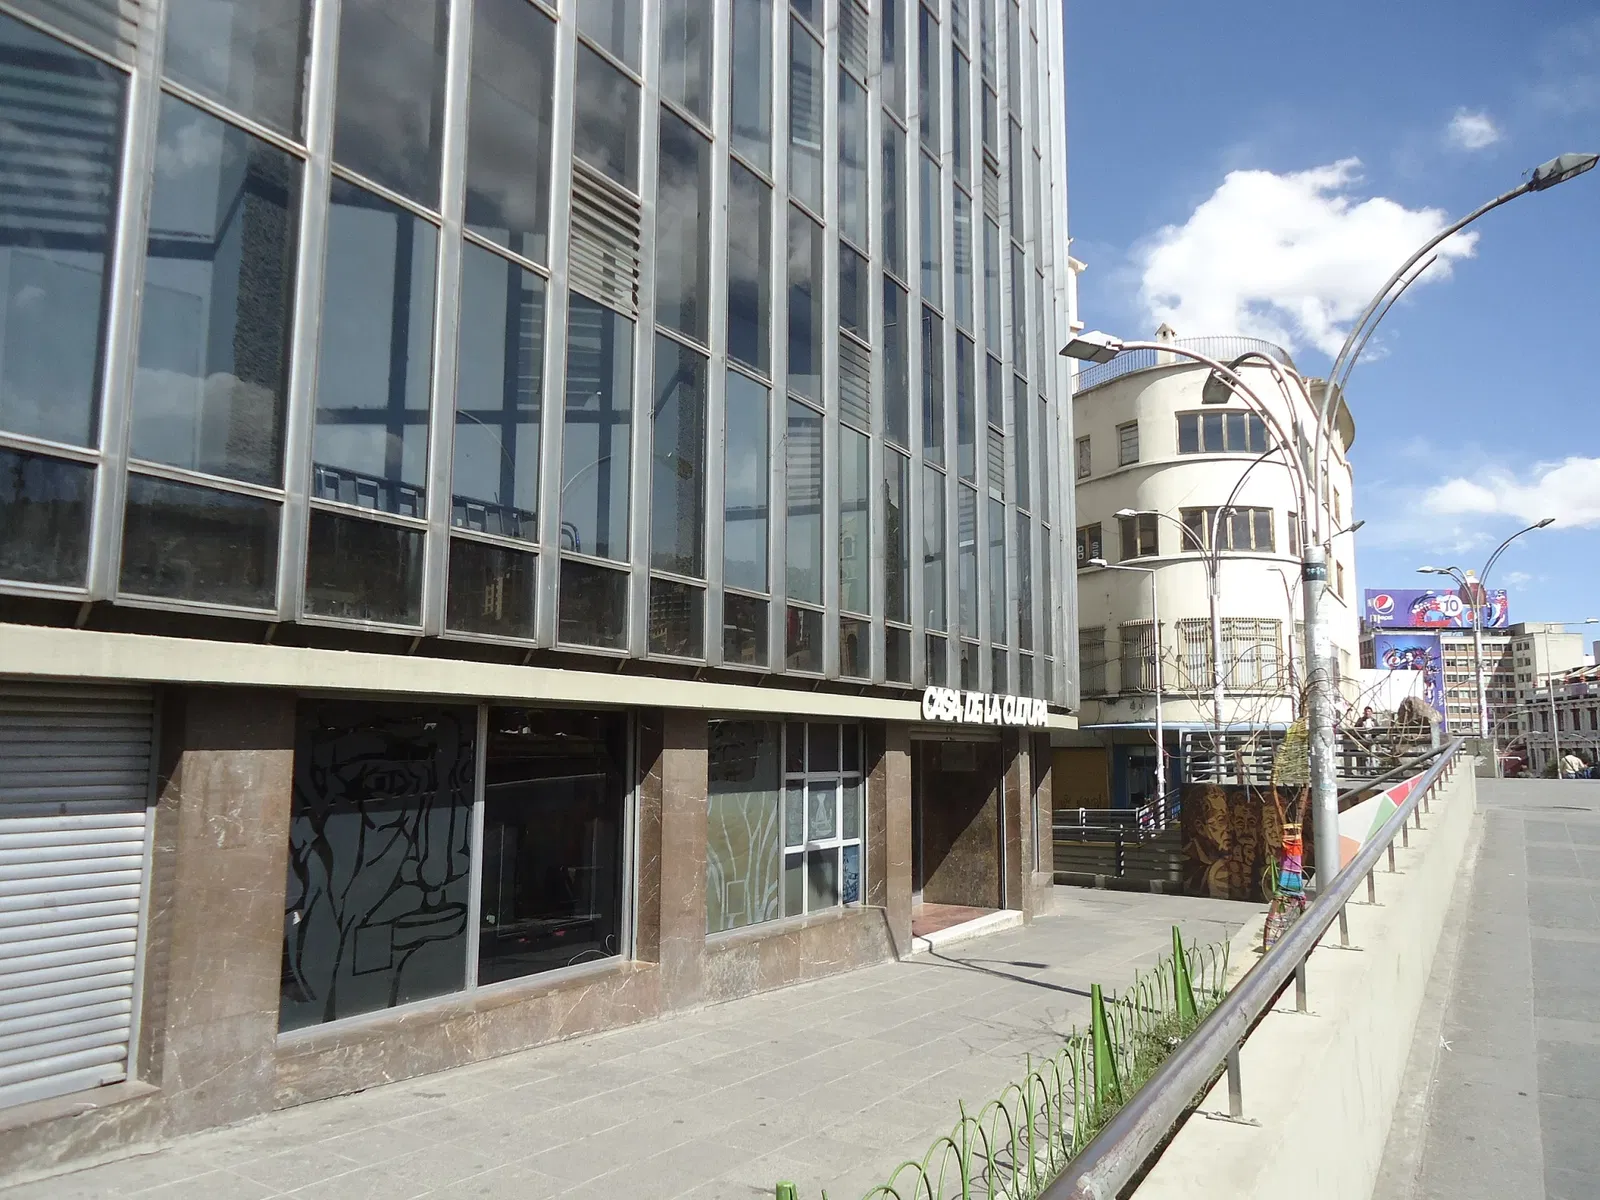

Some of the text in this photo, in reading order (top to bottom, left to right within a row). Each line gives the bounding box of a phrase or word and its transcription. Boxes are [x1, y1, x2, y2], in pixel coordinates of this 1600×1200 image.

[1444, 600, 1458, 611] 10
[922, 686, 1048, 727] CASA DE LA CULTURA
